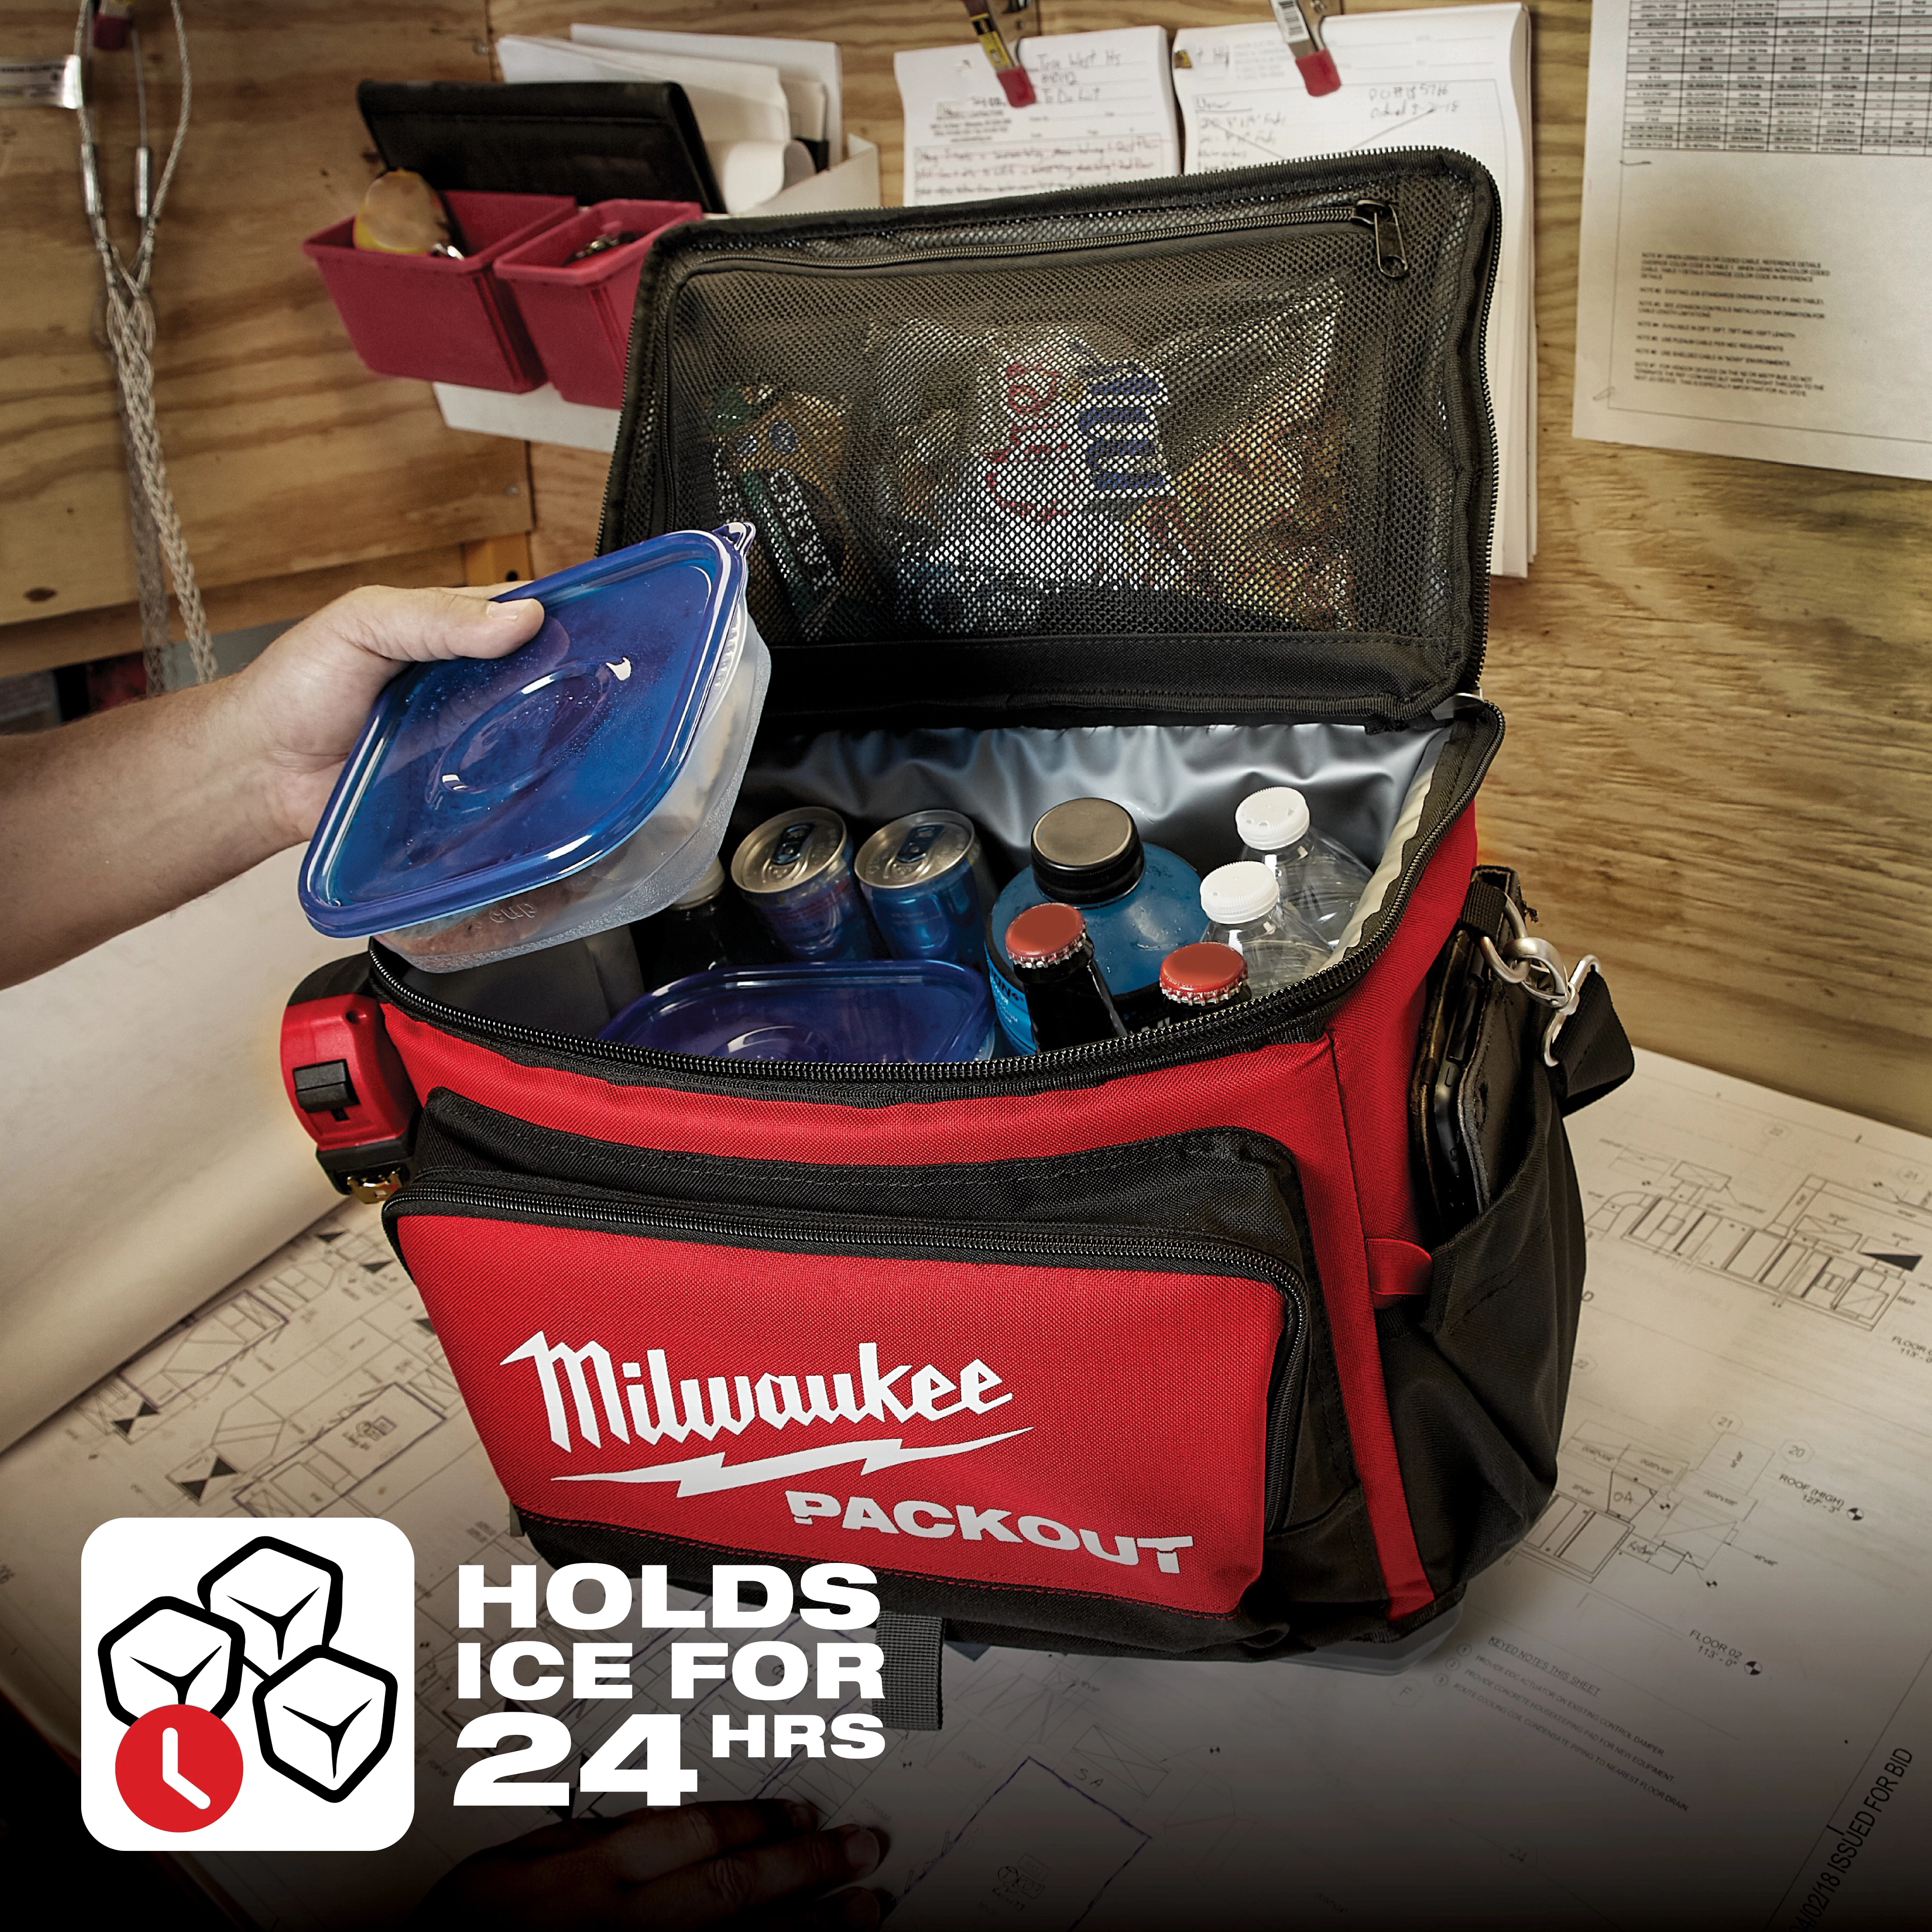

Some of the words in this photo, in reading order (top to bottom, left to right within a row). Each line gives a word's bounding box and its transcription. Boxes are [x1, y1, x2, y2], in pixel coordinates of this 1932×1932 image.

[499, 1330, 1013, 1453] Milwaukee
[1718, 1417, 1733, 1428] 21
[1788, 1445, 1805, 1457] 20
[1779, 1474, 1809, 1490] ROOF
[785, 1490, 1194, 1574] PACKOUT
[1690, 1630, 1727, 1652] FLOOR
[1728, 1648, 1742, 1659] 02
[1488, 1636, 1518, 1654] KEYED
[1518, 1650, 1548, 1670] NOTES
[1549, 1665, 1569, 1681] THIS
[1570, 1676, 1600, 1696] SHEET
[1567, 1701, 1599, 1720] EXISTING
[1600, 1718, 1631, 1739] CONTROL
[1598, 1737, 1615, 1749] FOR
[1615, 1747, 1632, 1759] NEW
[1595, 1756, 1605, 1765] TO
[1605, 1762, 1639, 1784] NEAREST
[1639, 1781, 1665, 1798] FLOOR
[1827, 1811, 1875, 1874] ISSUED
[1864, 1776, 1898, 1812] FOR
[1884, 1748, 1912, 1777] BID
